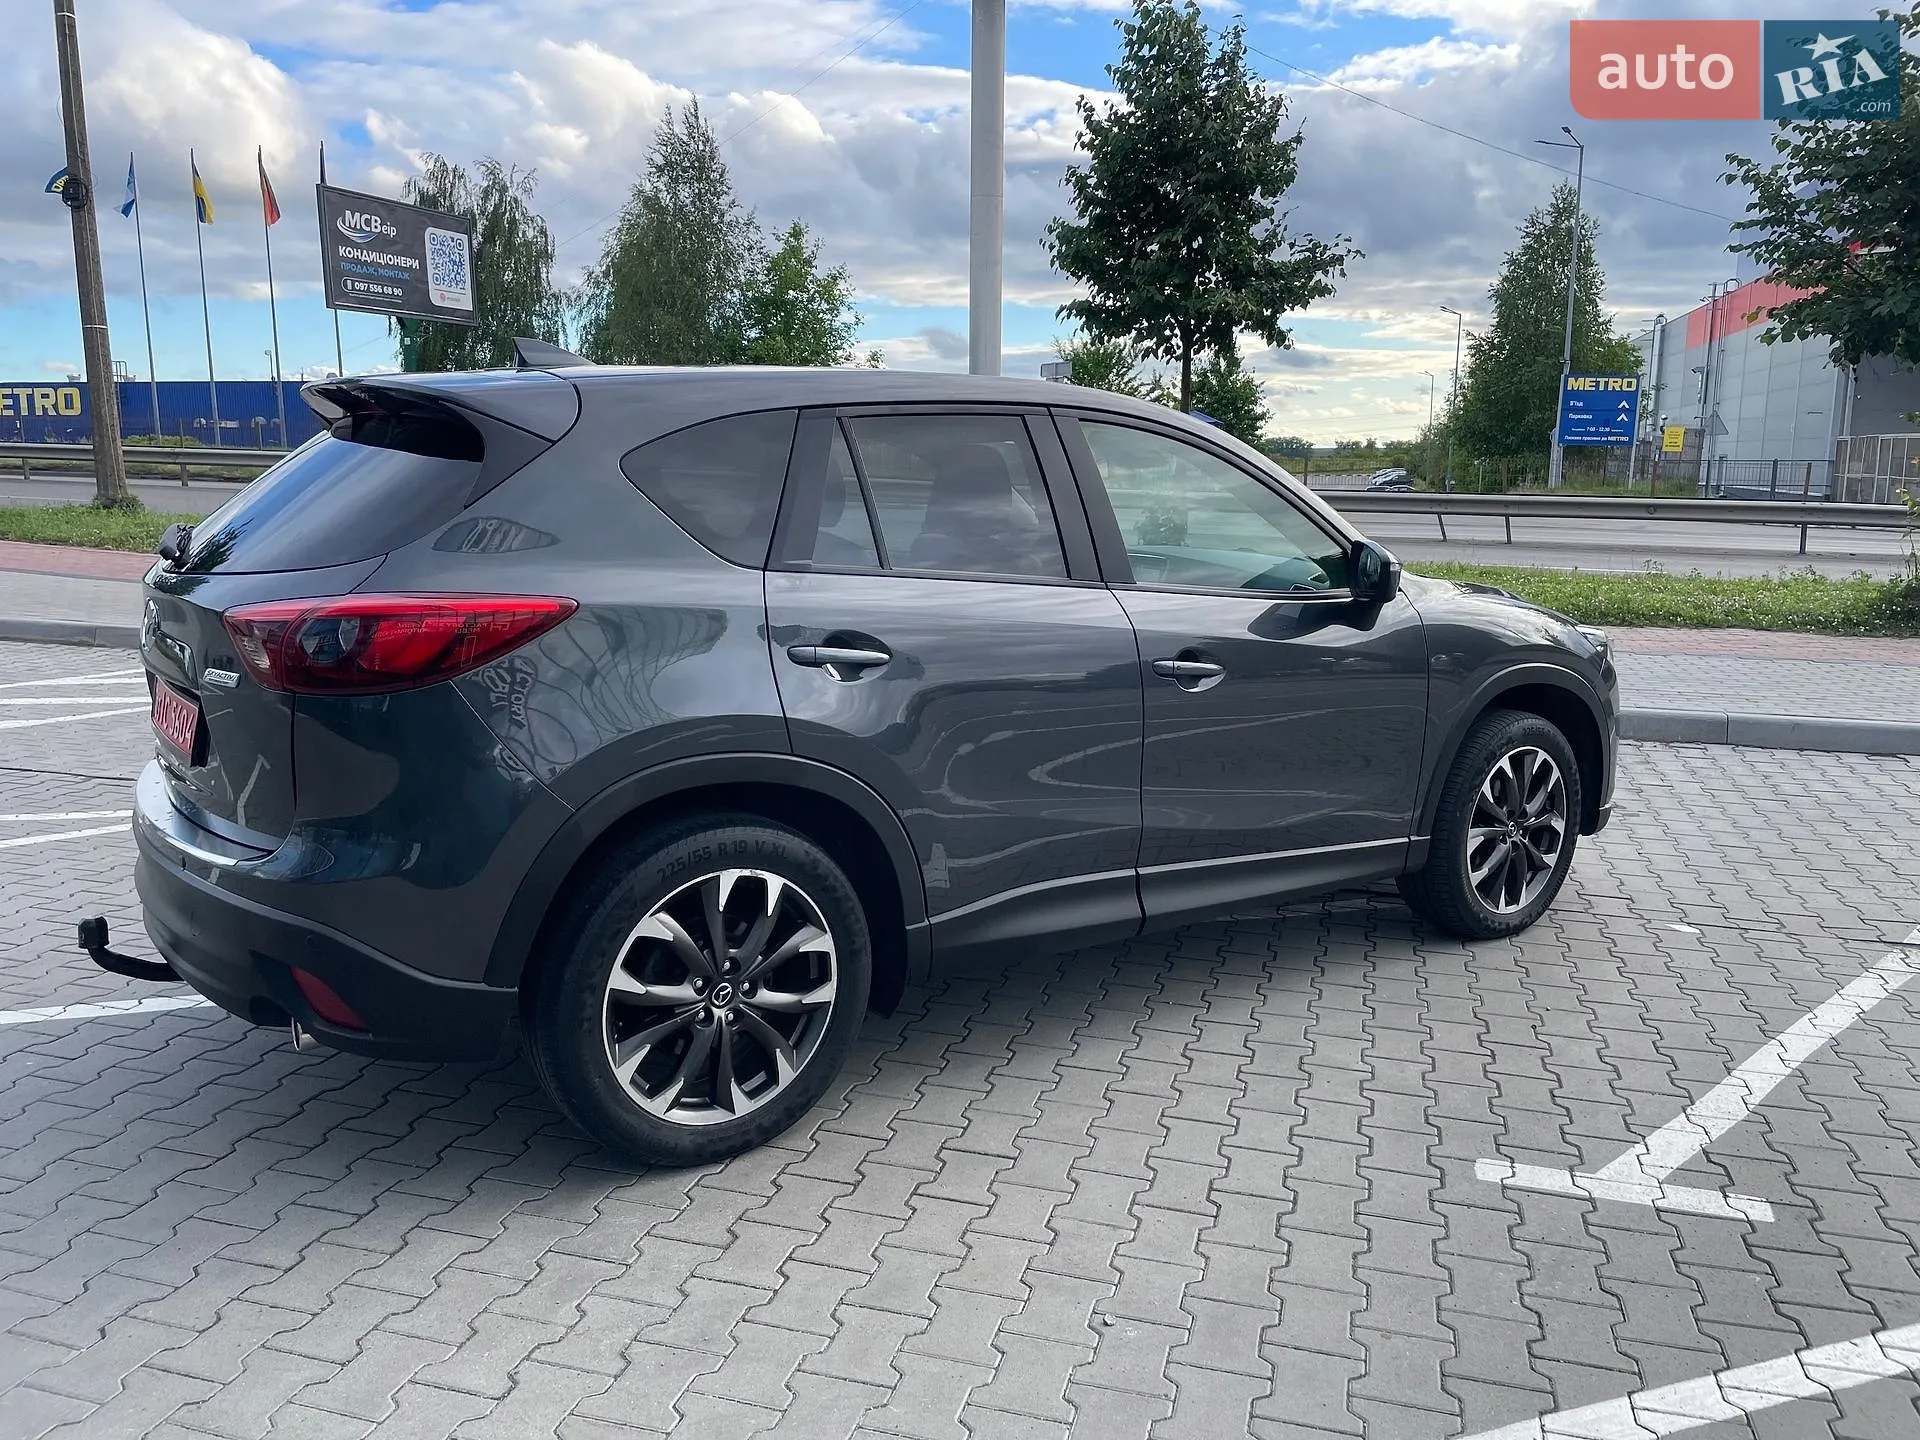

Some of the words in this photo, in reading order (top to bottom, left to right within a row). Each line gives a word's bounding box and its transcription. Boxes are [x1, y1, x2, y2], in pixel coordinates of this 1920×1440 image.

[338, 246, 420, 270] КОНДИЦІОНЕРИ
[378, 267, 410, 281] МОНТАЖ
[354, 282, 368, 291] 097
[393, 287, 403, 297] 90
[1567, 377, 1637, 391] METRO
[0, 387, 82, 416] ETRO
[656, 846, 713, 884] 225/55
